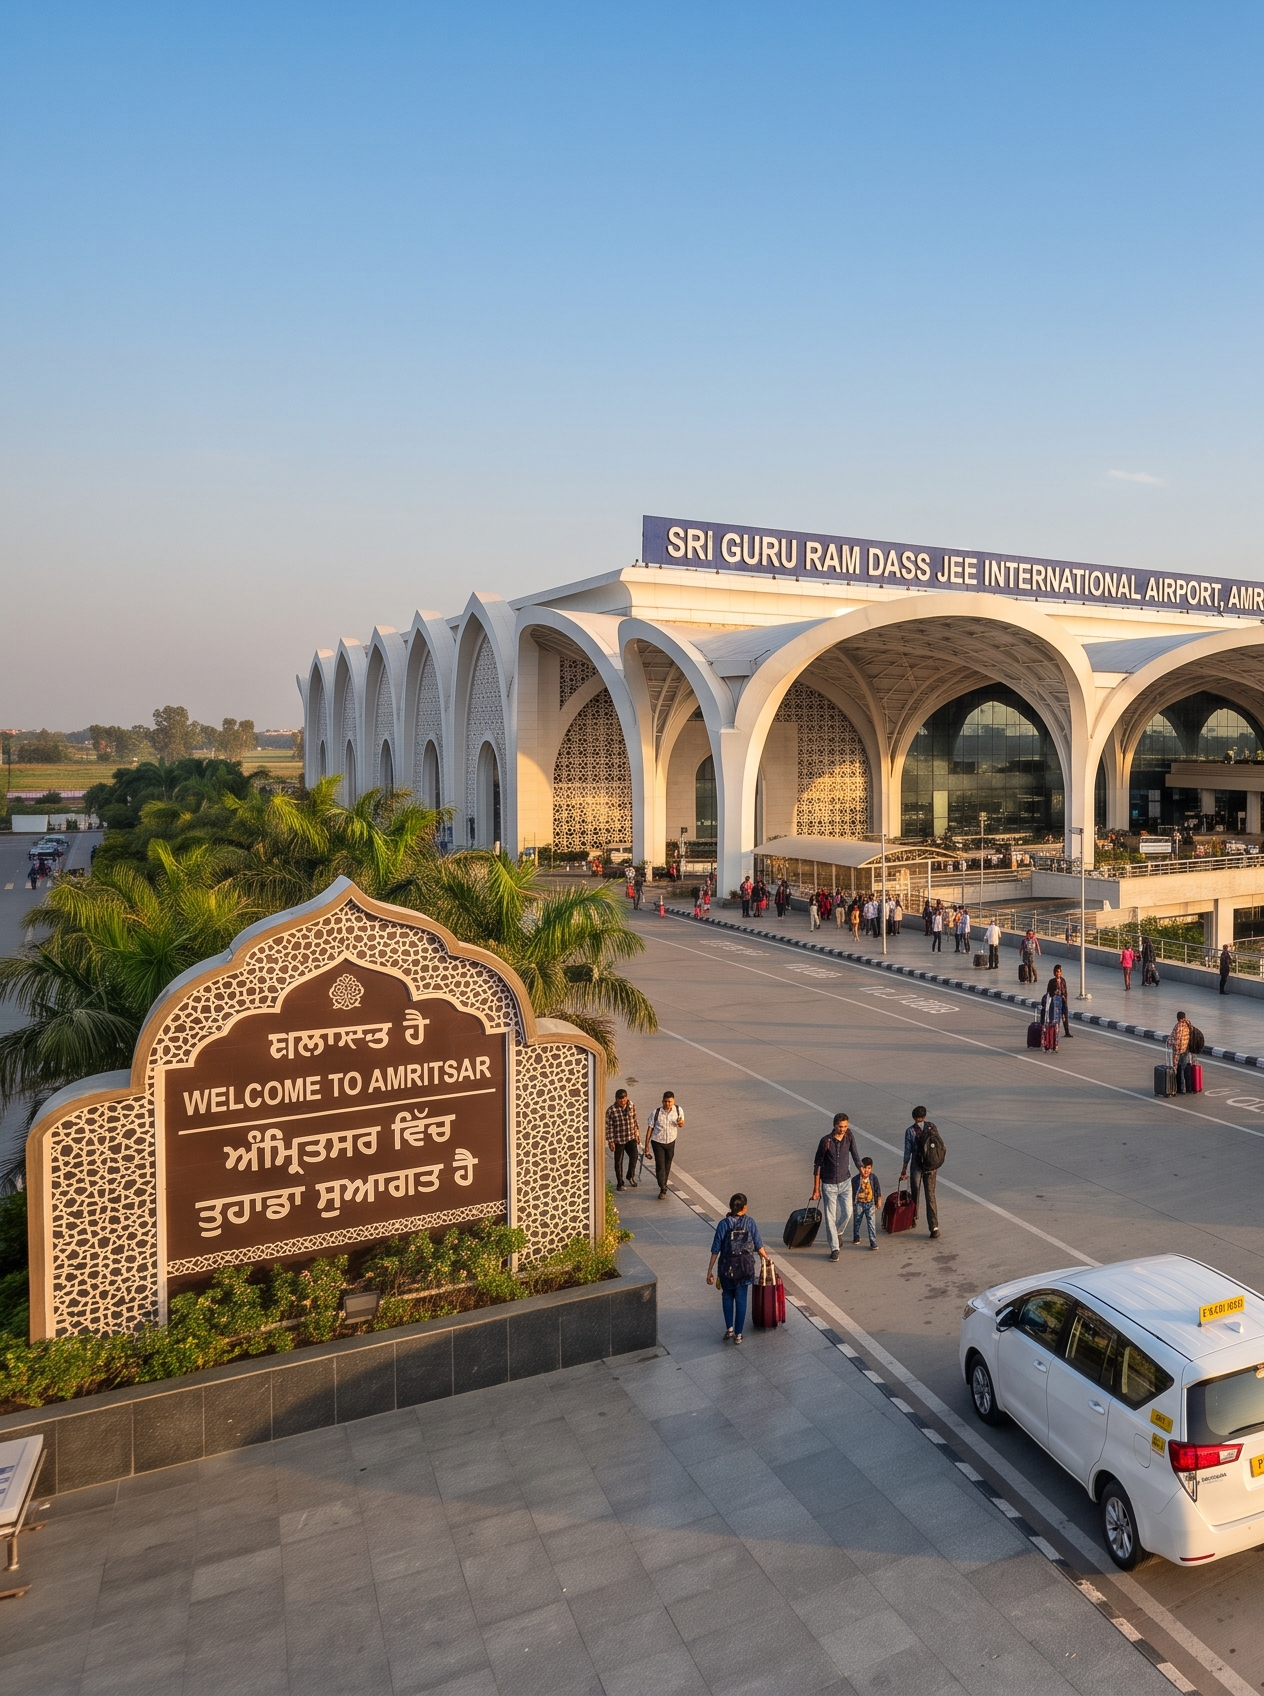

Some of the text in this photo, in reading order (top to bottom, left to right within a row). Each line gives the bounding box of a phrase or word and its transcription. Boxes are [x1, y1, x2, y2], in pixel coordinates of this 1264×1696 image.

[667, 526, 714, 561] SRI
[721, 532, 798, 569] GURU
[805, 541, 861, 575] RAM
[867, 548, 932, 582] DASS
[936, 555, 978, 585] JEE
[984, 559, 1141, 600] INTERNATIONAL
[1144, 577, 1226, 609] AIRPORT,
[183, 1056, 492, 1116] WELCOME TO AMRITSAR
[391, 1107, 456, 1150] ਵਿੱਚ
[195, 1148, 479, 1238] ਤੁਹਾਡਾ ਸੁਆਗਤ ਹੈ
